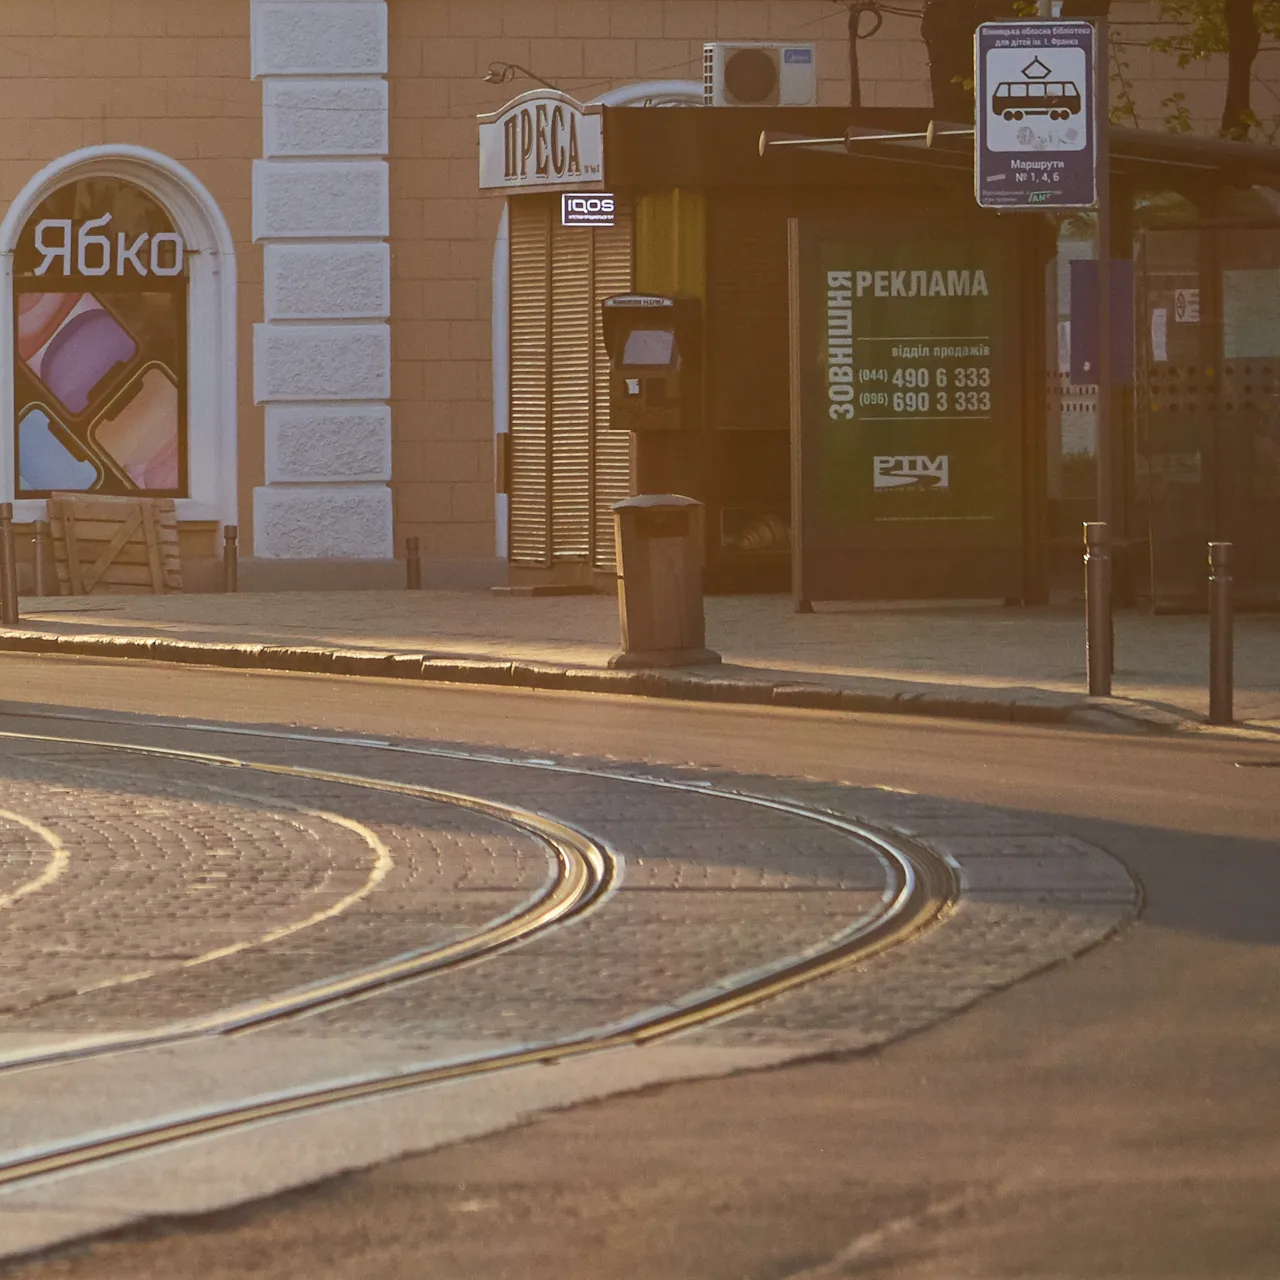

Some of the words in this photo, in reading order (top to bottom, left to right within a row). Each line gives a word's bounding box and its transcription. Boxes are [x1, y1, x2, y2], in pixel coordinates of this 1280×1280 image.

[503, 104, 582, 181] ПРЕСА
[1010, 159, 1065, 170] Маршрути
[1053, 172, 1060, 182] 6
[567, 199, 615, 214] IQOS
[33, 212, 183, 276] Ябко
[856, 269, 989, 297] РЕКЛАМА
[826, 270, 855, 420] ЗОВНІШНЯ
[892, 344, 930, 359] відділ
[933, 343, 989, 360] продажів
[858, 368, 888, 383] (044)
[892, 368, 929, 388] 490
[936, 368, 948, 388] 6
[954, 367, 990, 388] 333
[858, 392, 888, 407] (096)
[893, 391, 929, 412] 690
[936, 391, 948, 412] 3
[954, 391, 991, 411] 333
